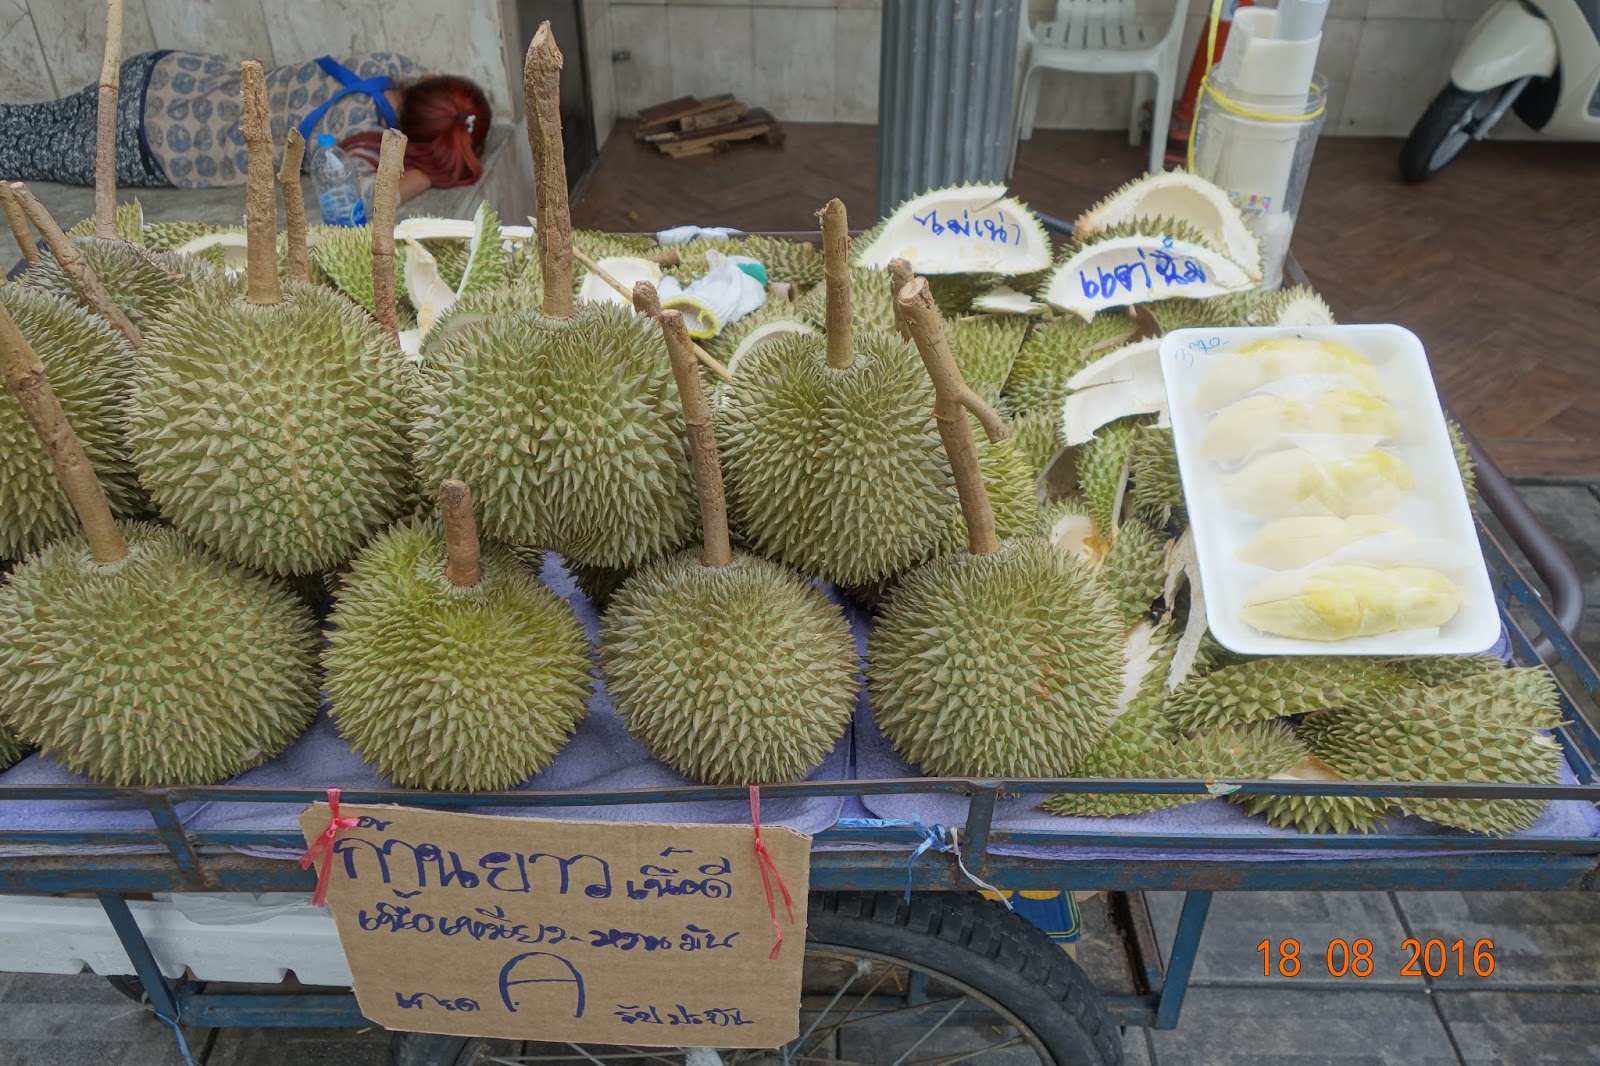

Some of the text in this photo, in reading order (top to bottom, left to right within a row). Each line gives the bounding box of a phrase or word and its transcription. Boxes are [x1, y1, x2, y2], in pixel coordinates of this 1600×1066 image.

[333, 815, 612, 899] ก้านยาว
[498, 951, 586, 1019] A
